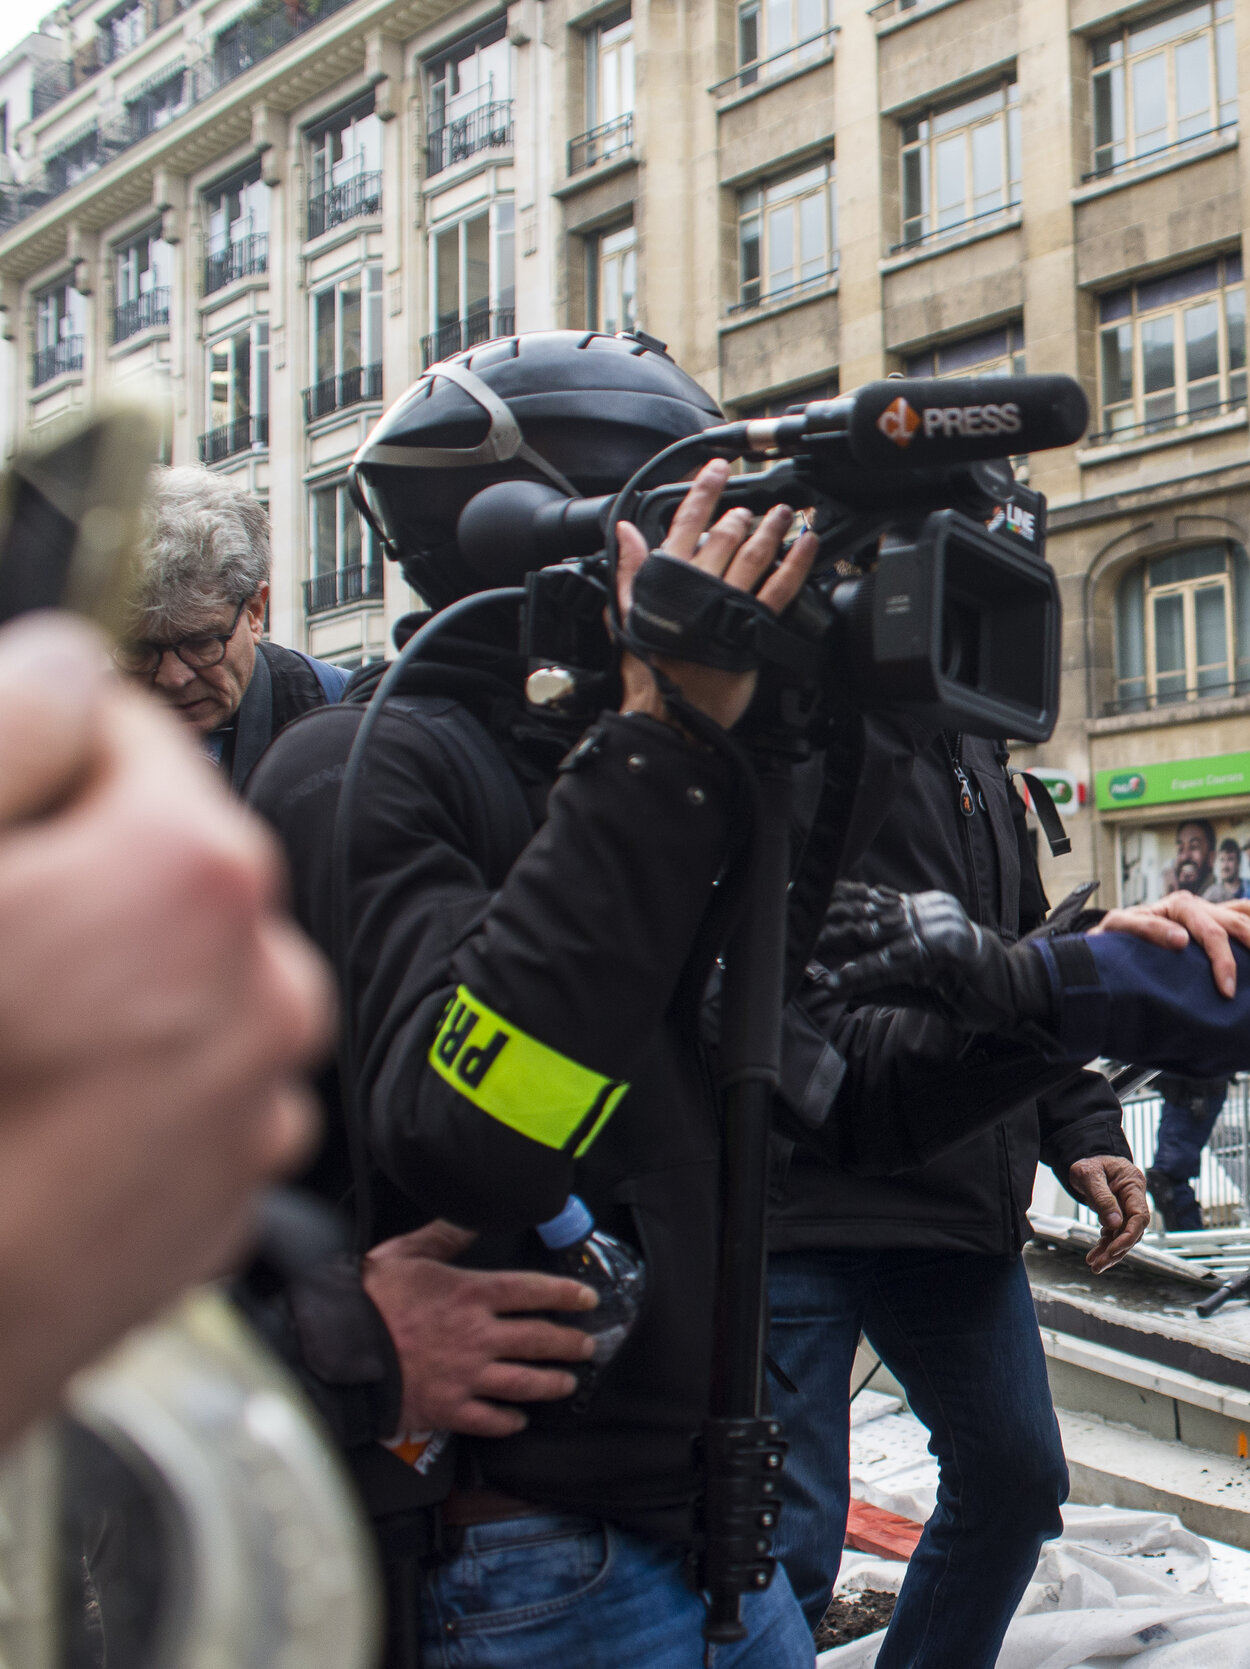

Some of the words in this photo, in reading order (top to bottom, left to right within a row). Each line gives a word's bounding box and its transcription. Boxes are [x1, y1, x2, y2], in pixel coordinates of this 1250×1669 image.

[923, 403, 1021, 438] PRESS
[1171, 778, 1204, 791] Espace
[1206, 773, 1244, 786] Courses
[436, 1000, 510, 1091] PR
